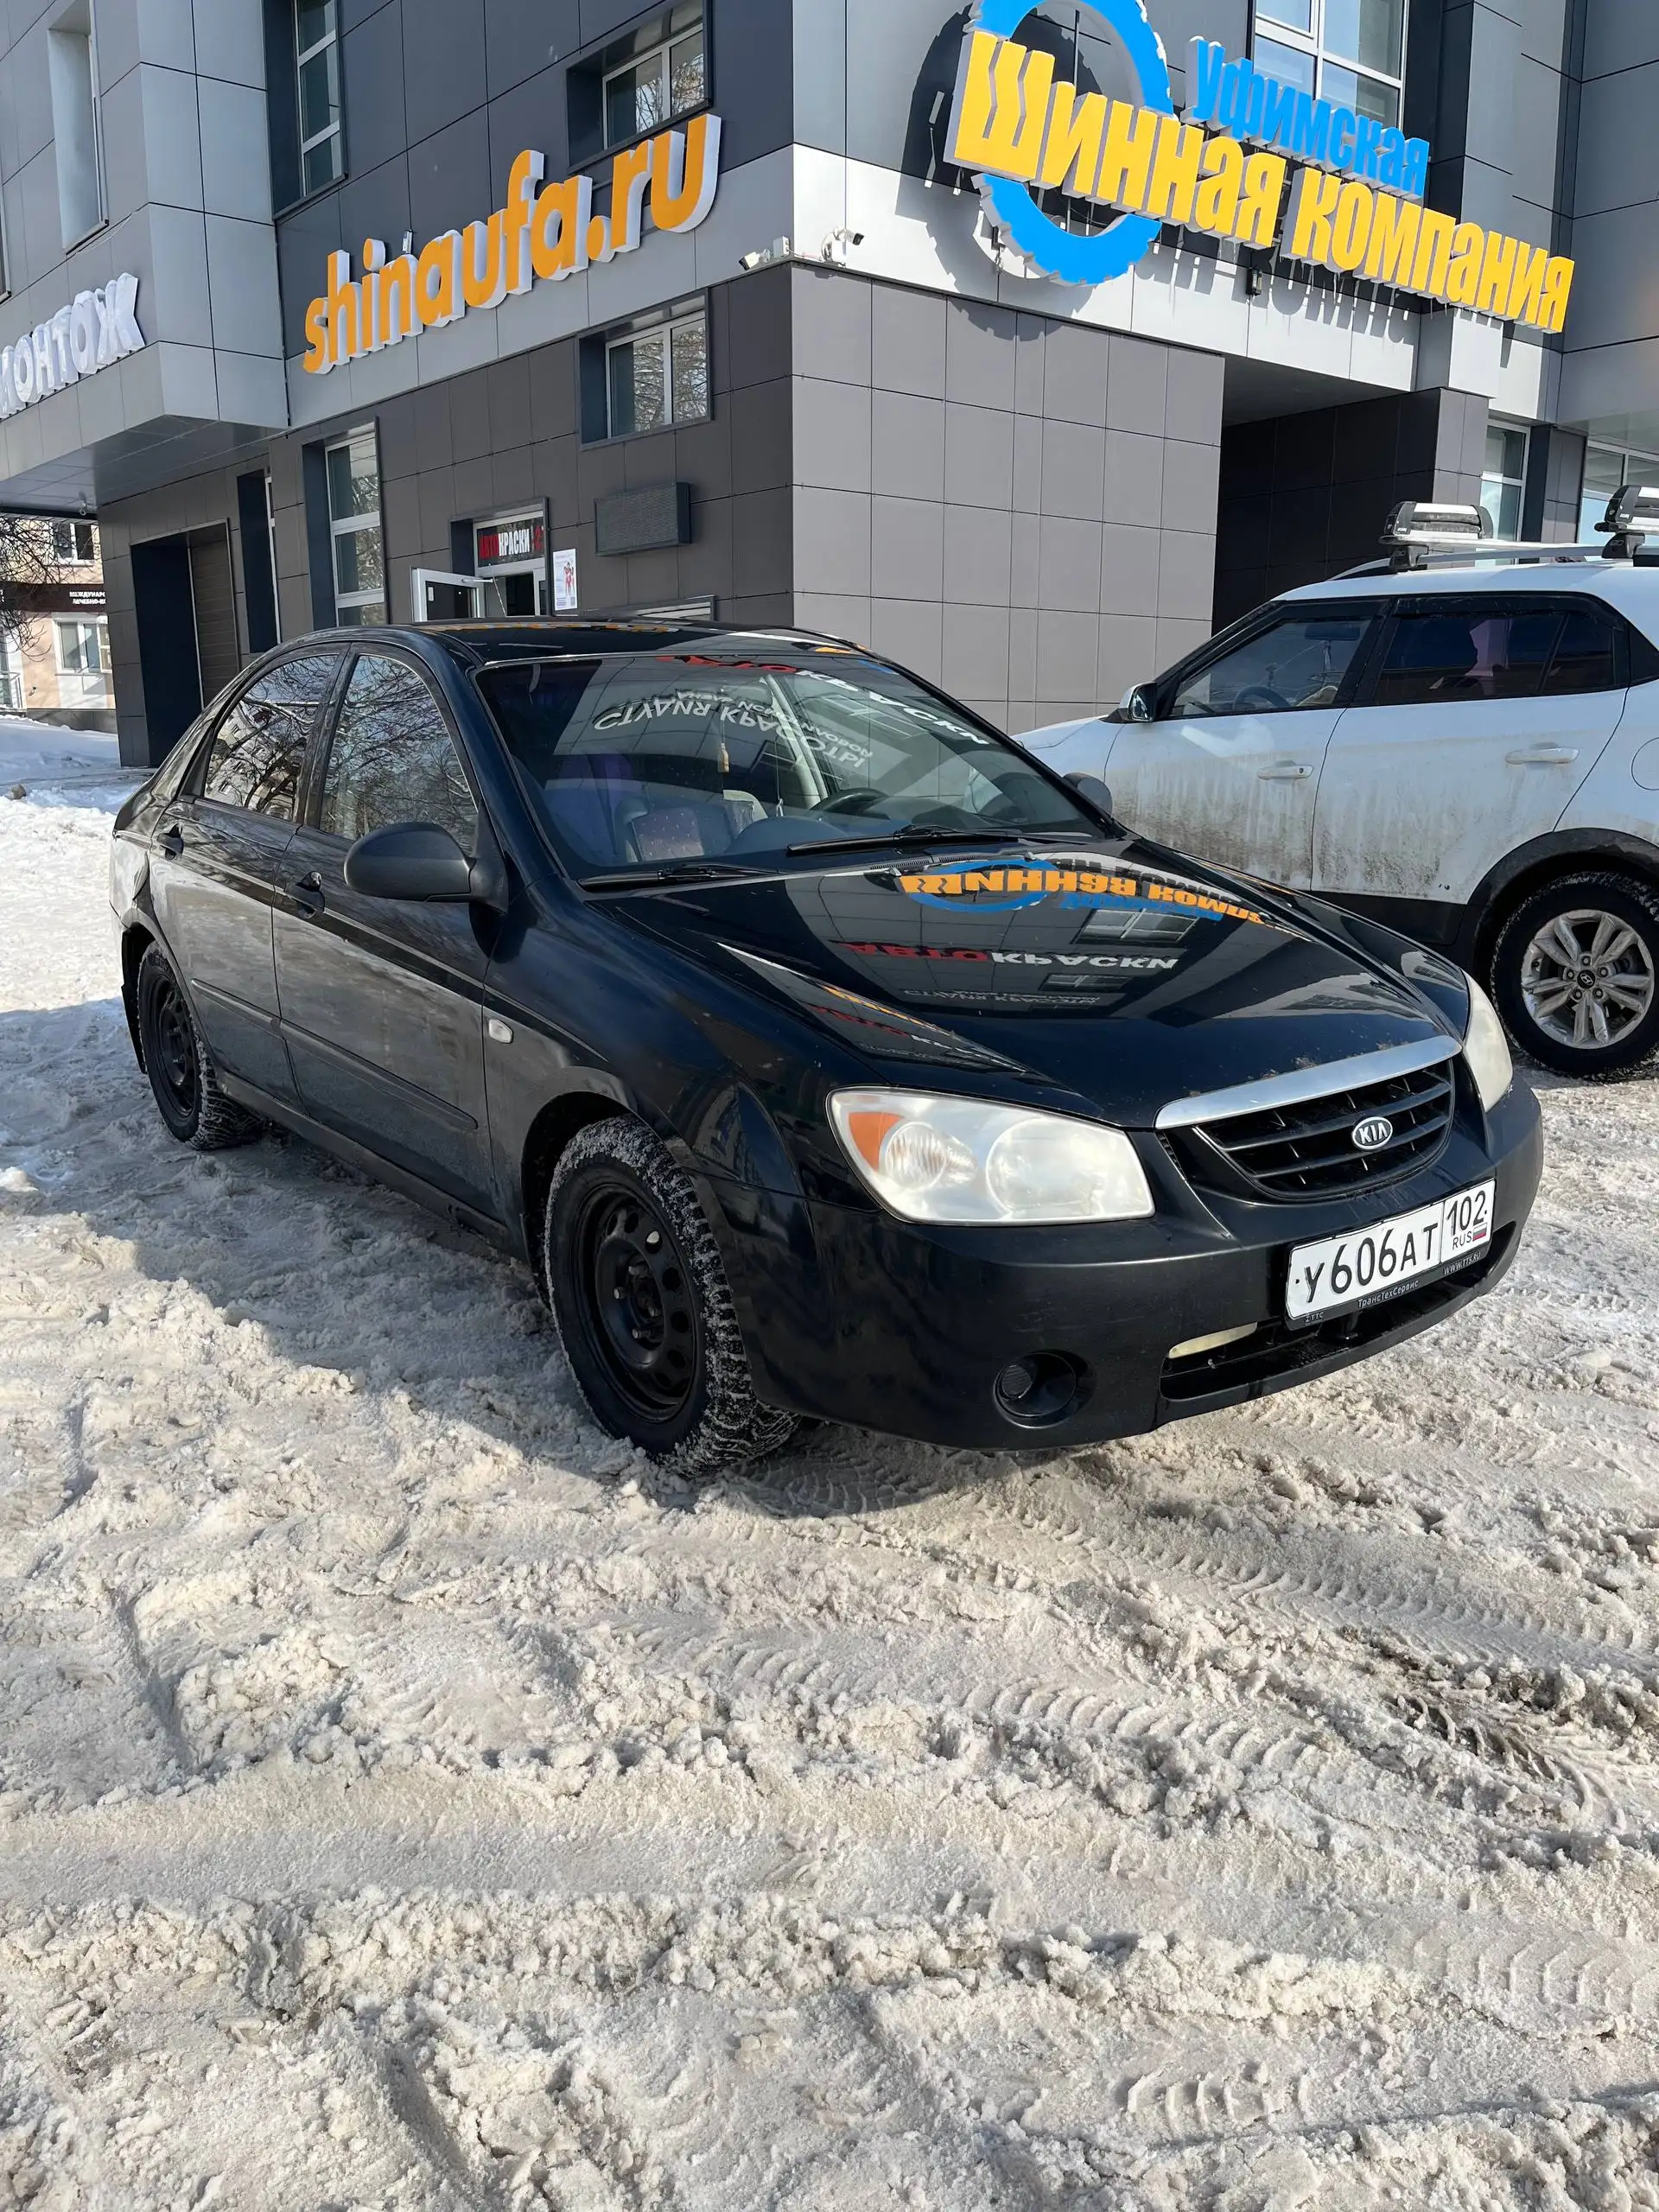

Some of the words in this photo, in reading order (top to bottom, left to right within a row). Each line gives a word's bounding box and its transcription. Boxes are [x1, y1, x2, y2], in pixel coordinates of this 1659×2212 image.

[1184, 37, 1429, 200] Уфимская
[945, 30, 1287, 248] Шинная
[1282, 167, 1575, 334] компания
[302, 113, 722, 375] shinaufa.ru
[1358, 1122, 1388, 1144] KIA
[1305, 1223, 1438, 1303] У606АТ
[1446, 1190, 1485, 1236] 102
[1357, 1280, 1419, 1308] ТрансТехСервис
[1452, 1231, 1472, 1250] RUS
